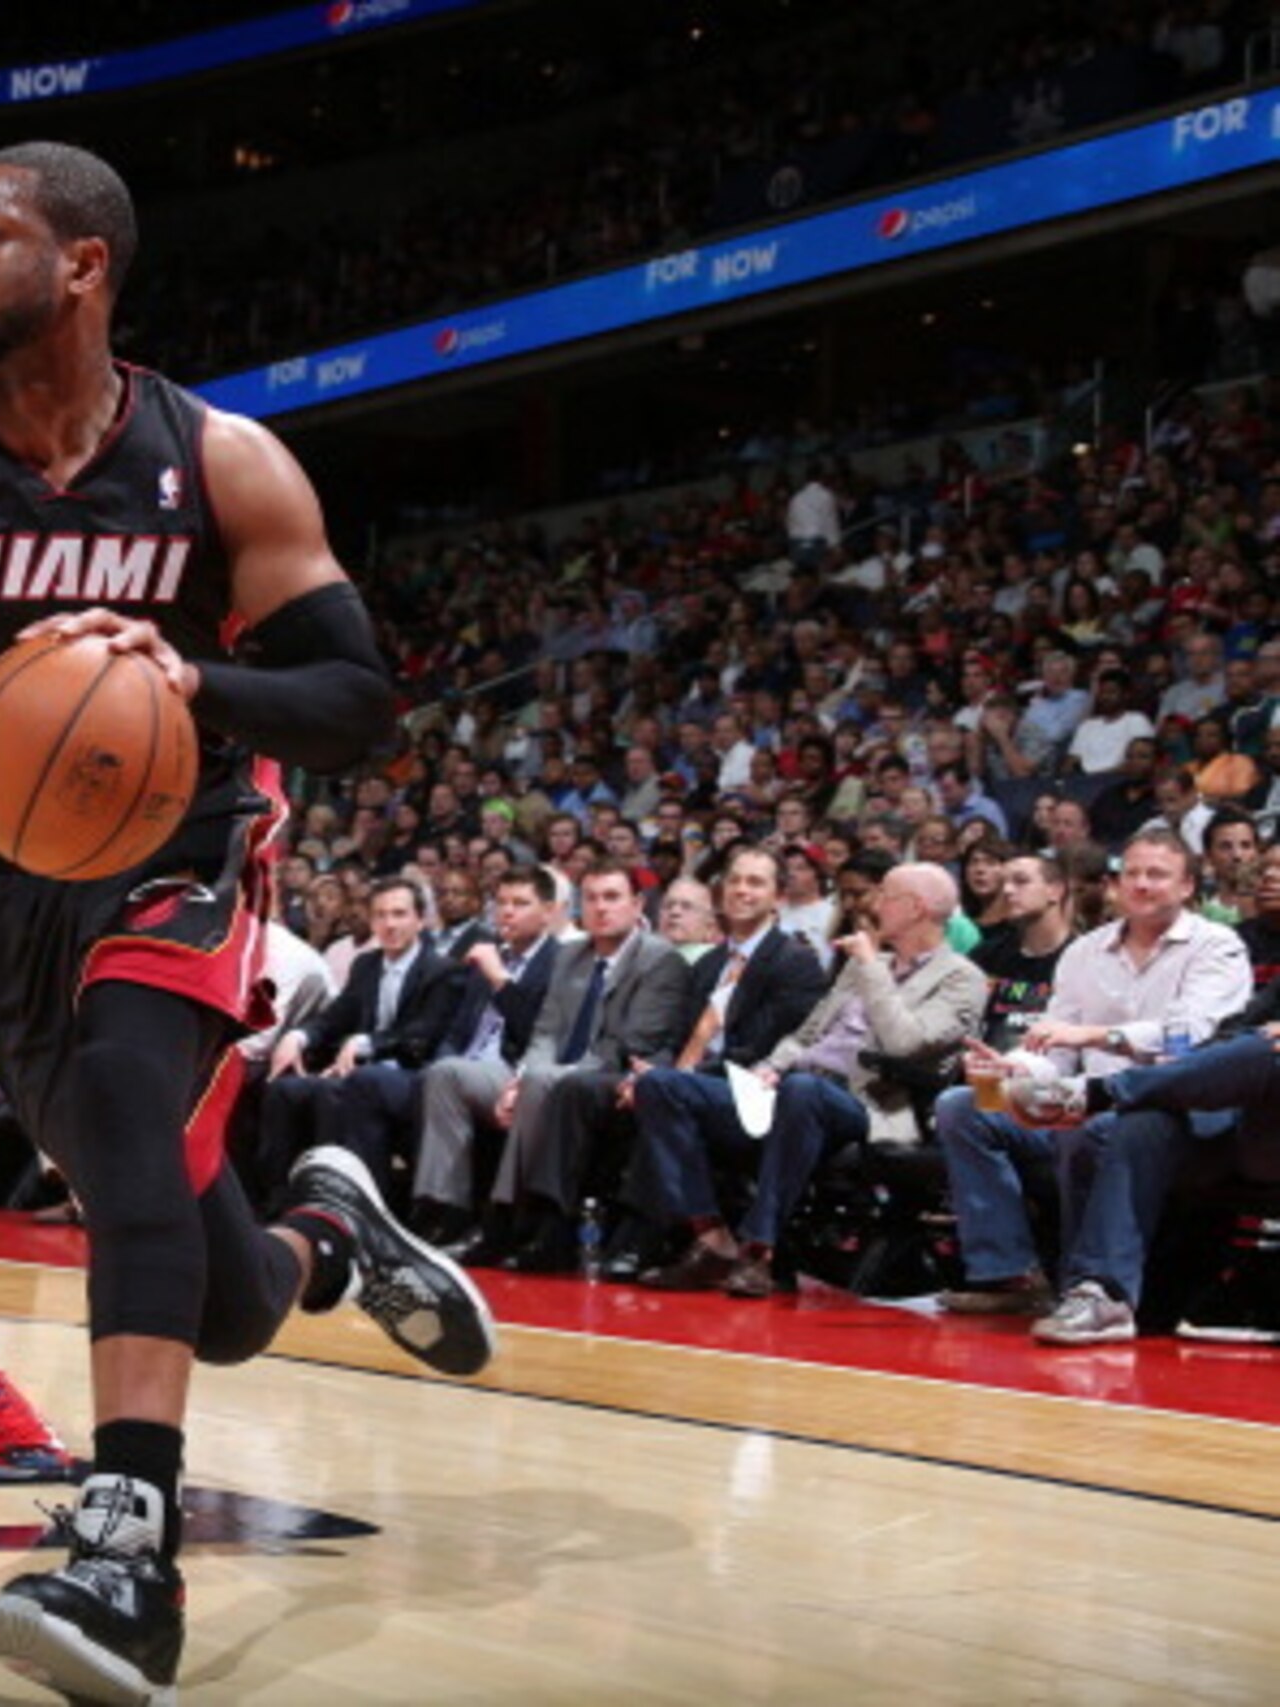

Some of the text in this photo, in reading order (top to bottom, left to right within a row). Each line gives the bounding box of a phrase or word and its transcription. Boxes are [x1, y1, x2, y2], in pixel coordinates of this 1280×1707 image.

[10, 61, 89, 100] NOW
[1173, 97, 1249, 152] FOR
[646, 243, 777, 291] FOR NOW
[267, 353, 367, 389] FOR NOW
